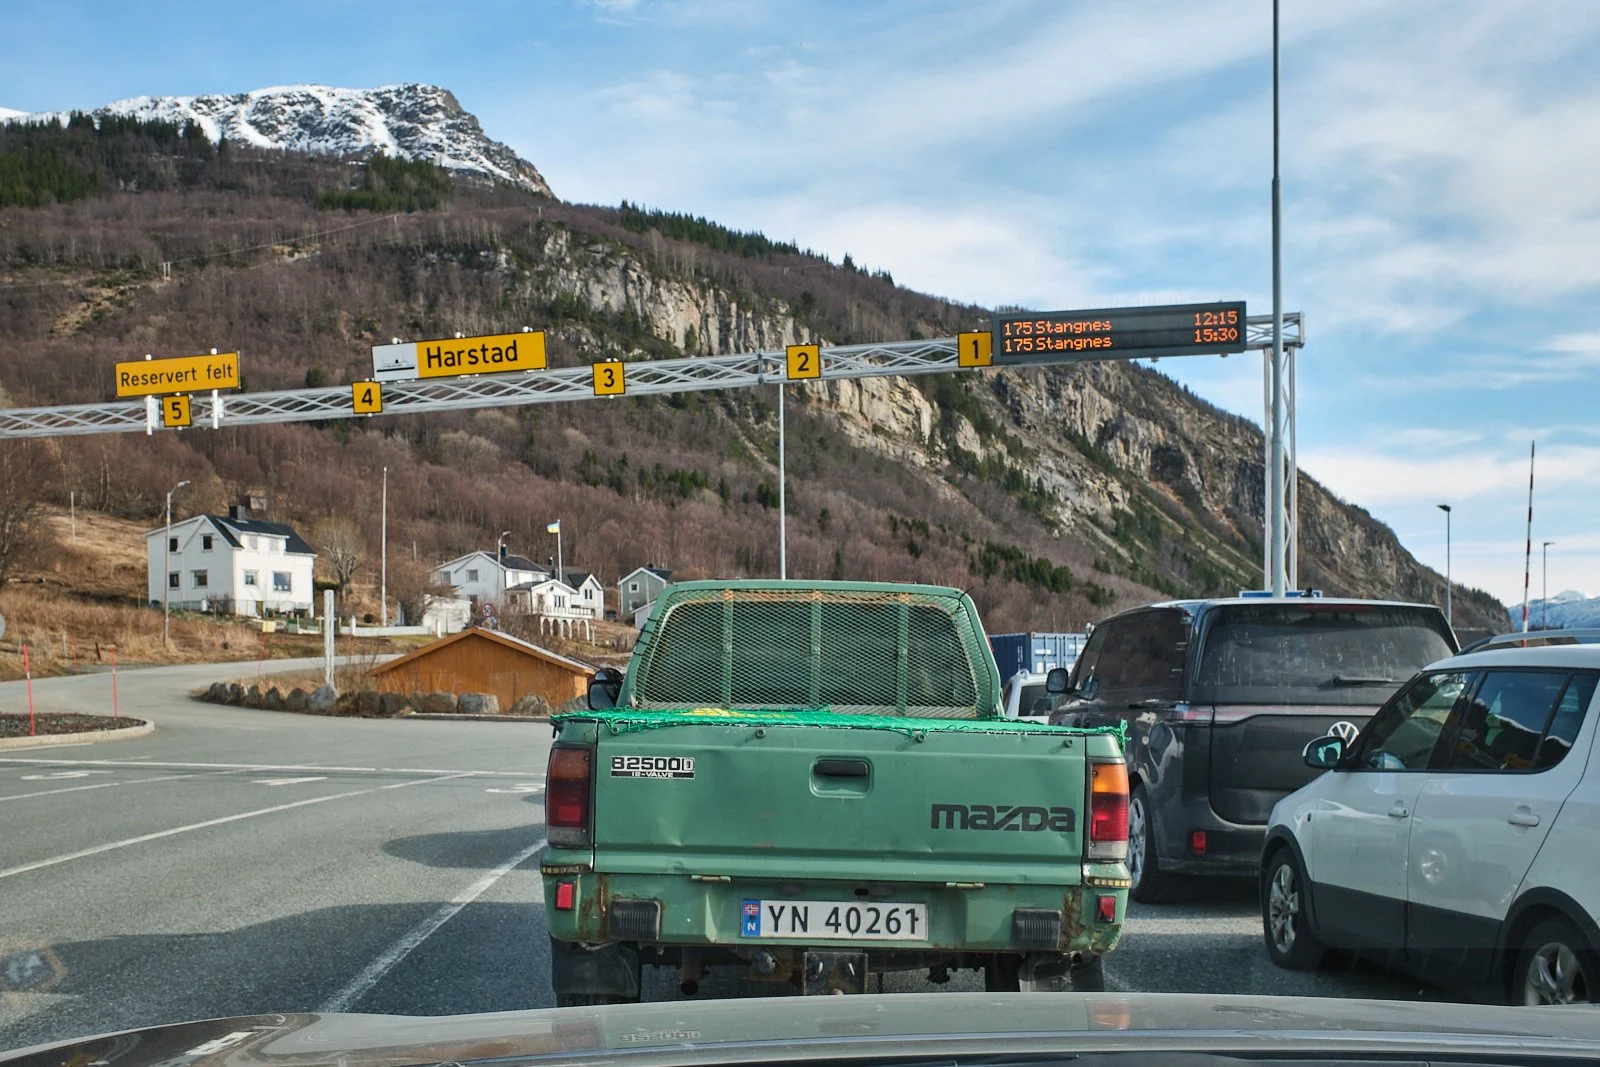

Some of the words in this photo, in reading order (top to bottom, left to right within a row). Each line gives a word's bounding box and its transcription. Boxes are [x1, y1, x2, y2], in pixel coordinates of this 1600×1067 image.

[1004, 322, 1033, 336] 175
[1035, 320, 1112, 334] Stangnes
[1194, 310, 1238, 326] 12:15
[972, 339, 979, 359] 1
[1005, 338, 1033, 352] 175
[1035, 336, 1113, 351] Stangnes
[1194, 327, 1238, 343] 15:30
[427, 339, 518, 369] Harstad
[797, 352, 810, 372] 2
[120, 367, 197, 388] Reservert
[206, 363, 233, 380] felt
[603, 368, 615, 388] 3
[361, 388, 373, 406] 4
[171, 401, 182, 420] 5
[611, 757, 695, 771] B2500D
[747, 922, 756, 932] N
[768, 905, 808, 932] YN
[825, 906, 919, 935] 40261
